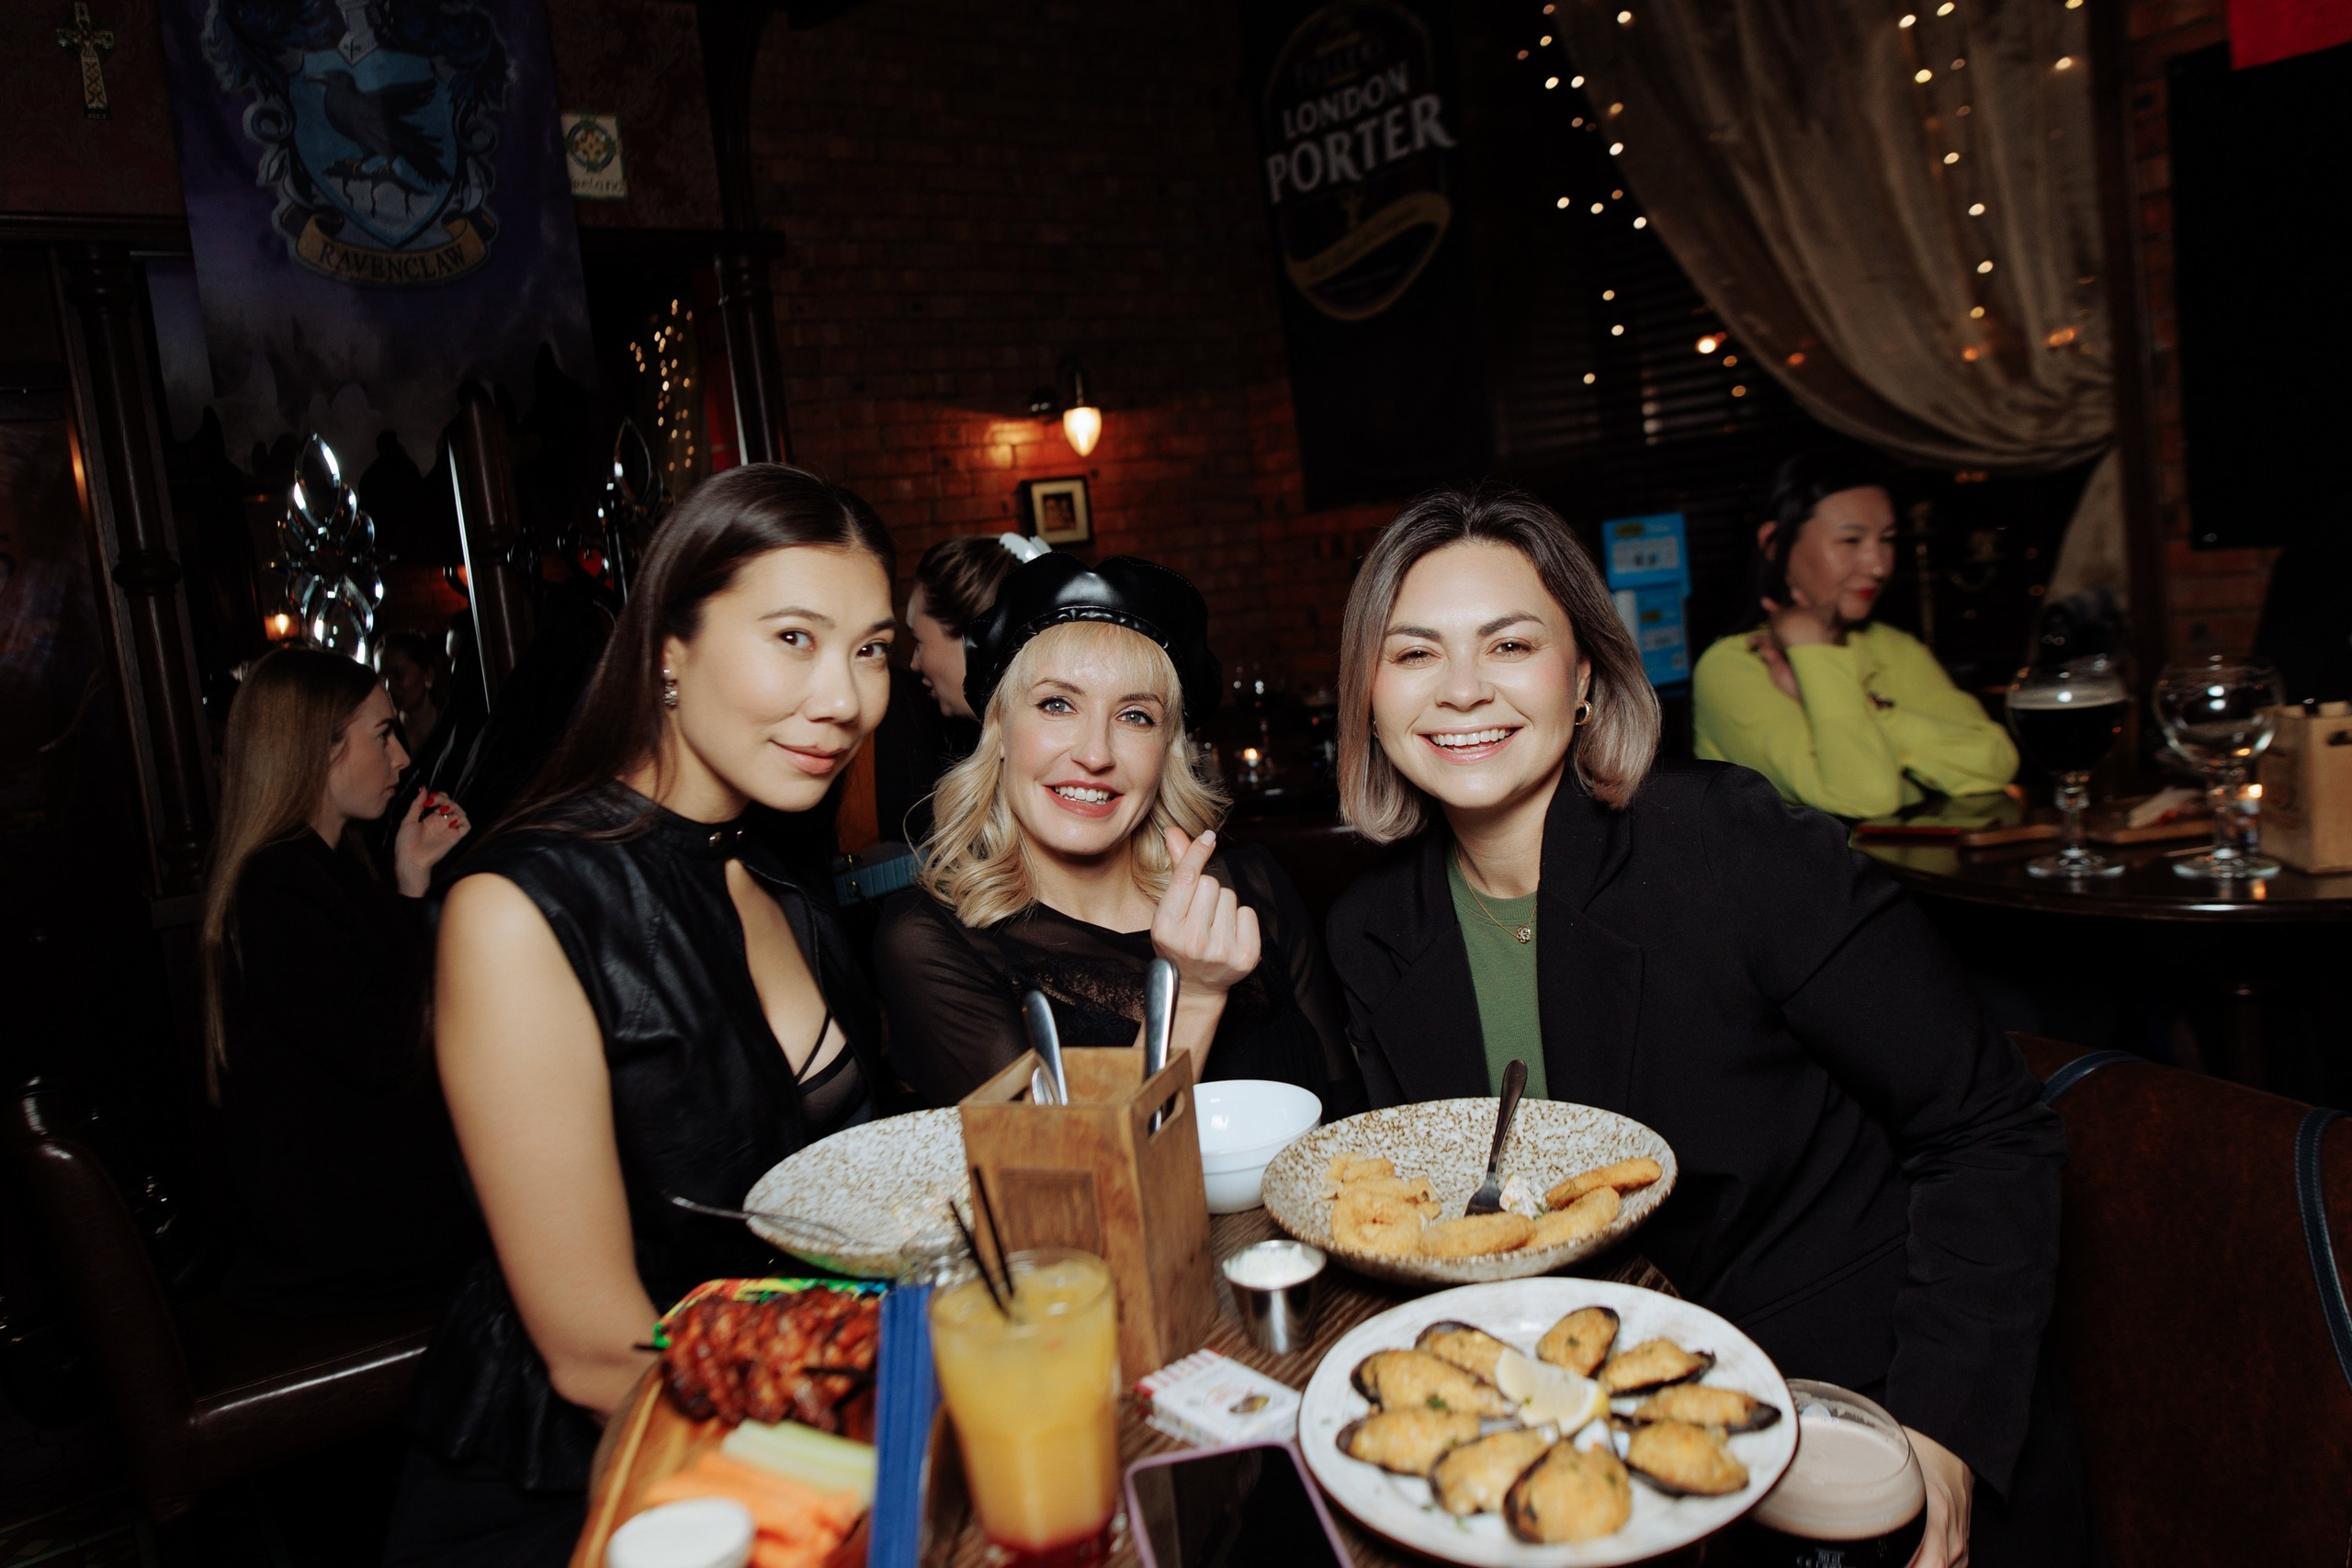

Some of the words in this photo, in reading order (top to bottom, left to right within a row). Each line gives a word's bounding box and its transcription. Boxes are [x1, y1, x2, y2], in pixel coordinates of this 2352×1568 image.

[1283, 60, 1408, 141] LONDON
[1265, 94, 1457, 205] PORTER
[320, 243, 466, 281] RAVENCLAW
